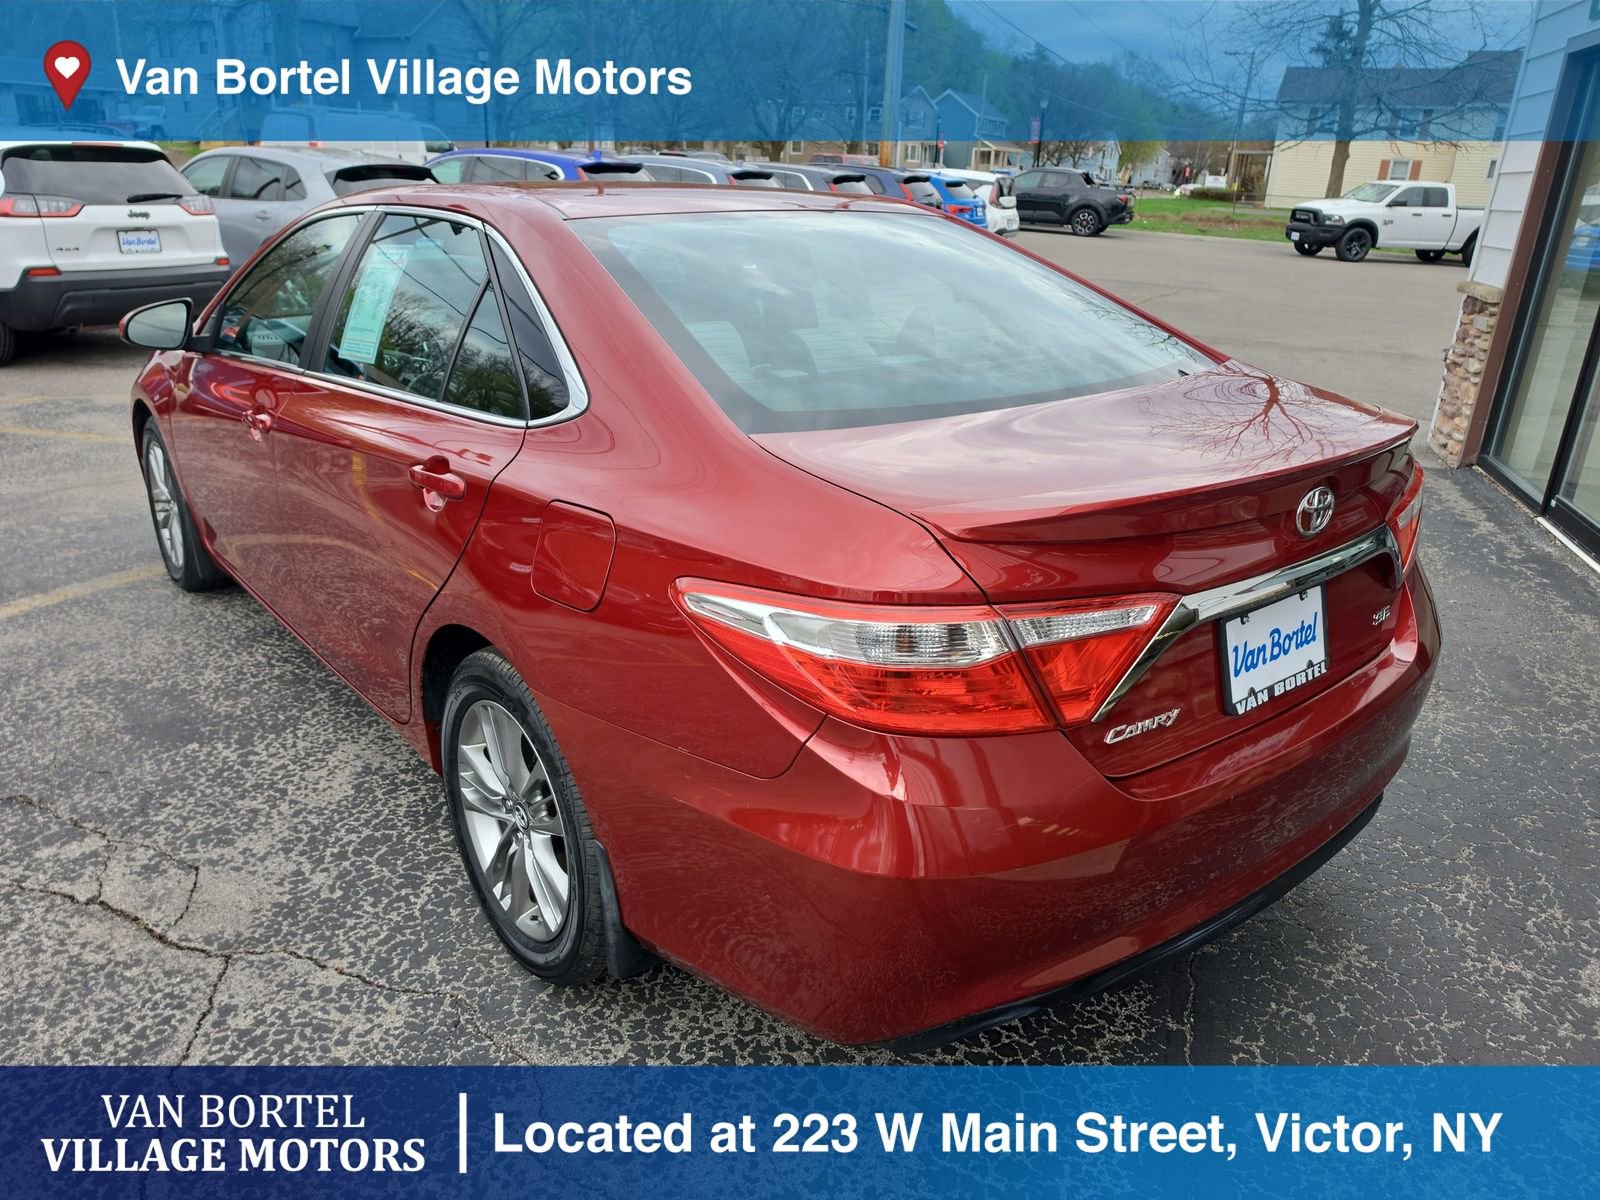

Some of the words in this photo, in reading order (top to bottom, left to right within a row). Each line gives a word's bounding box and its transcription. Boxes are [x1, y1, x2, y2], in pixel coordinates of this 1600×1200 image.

[1232, 641, 1268, 679] Van
[1268, 611, 1320, 662] Bortel
[1235, 688, 1270, 716] VAN
[1273, 660, 1328, 697] BORTEL
